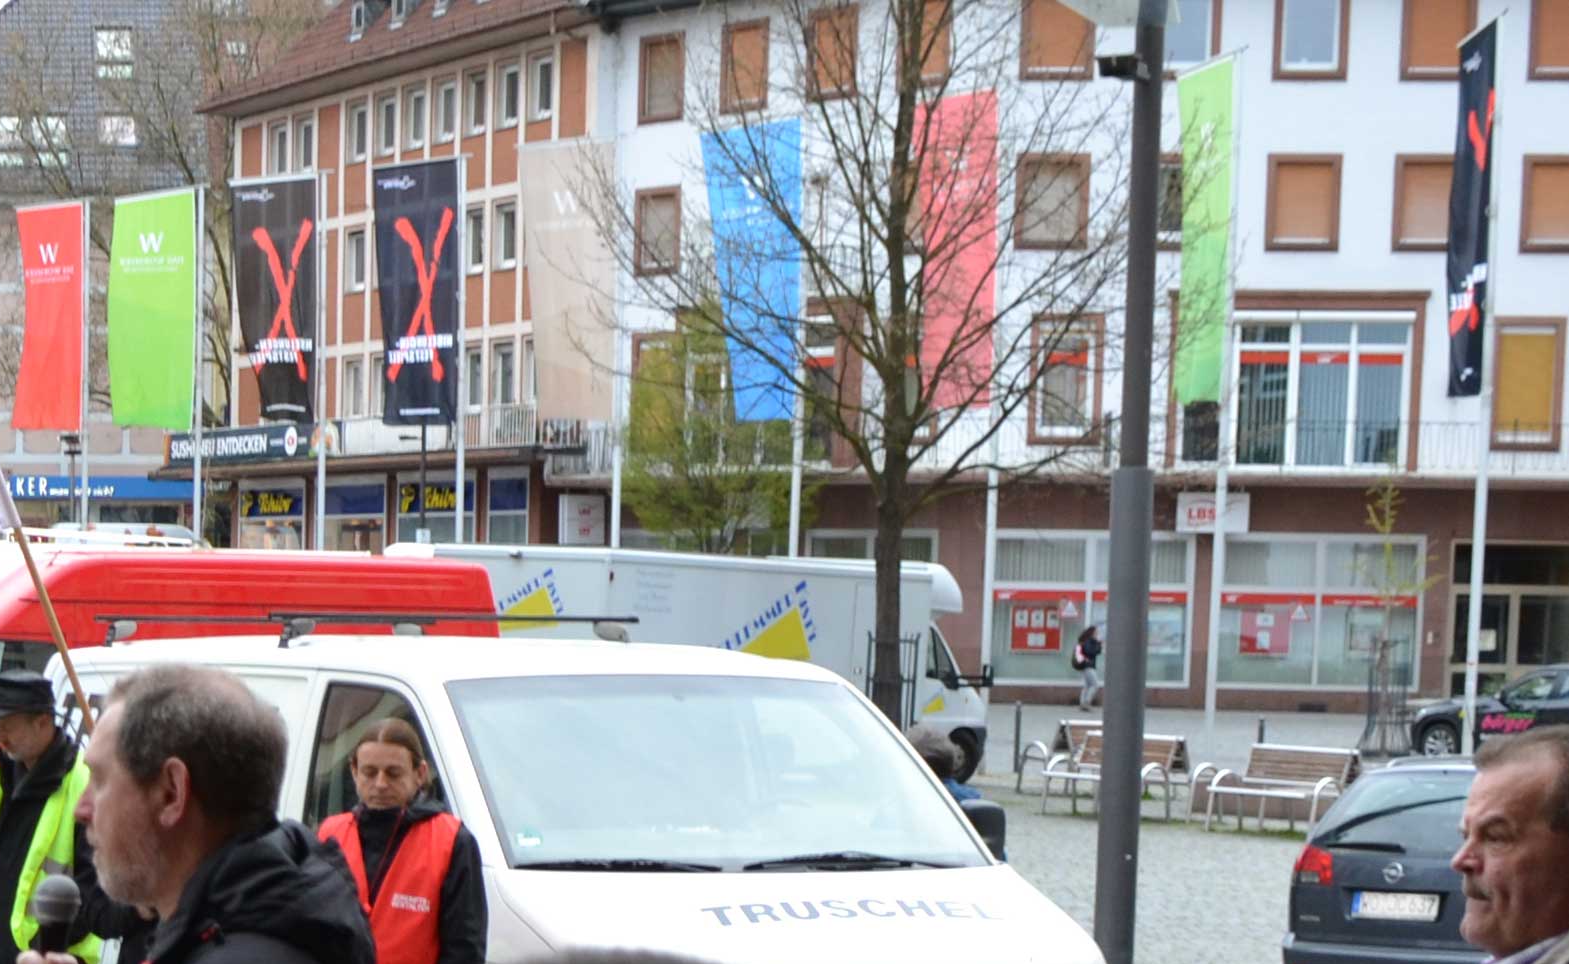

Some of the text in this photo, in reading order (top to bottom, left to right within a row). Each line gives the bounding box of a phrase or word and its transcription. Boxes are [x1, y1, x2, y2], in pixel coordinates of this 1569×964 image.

[39, 243, 58, 264] W
[138, 231, 163, 254] W
[216, 434, 268, 457] ENTDECKEN
[699, 899, 1006, 926] TRUSCHEL
